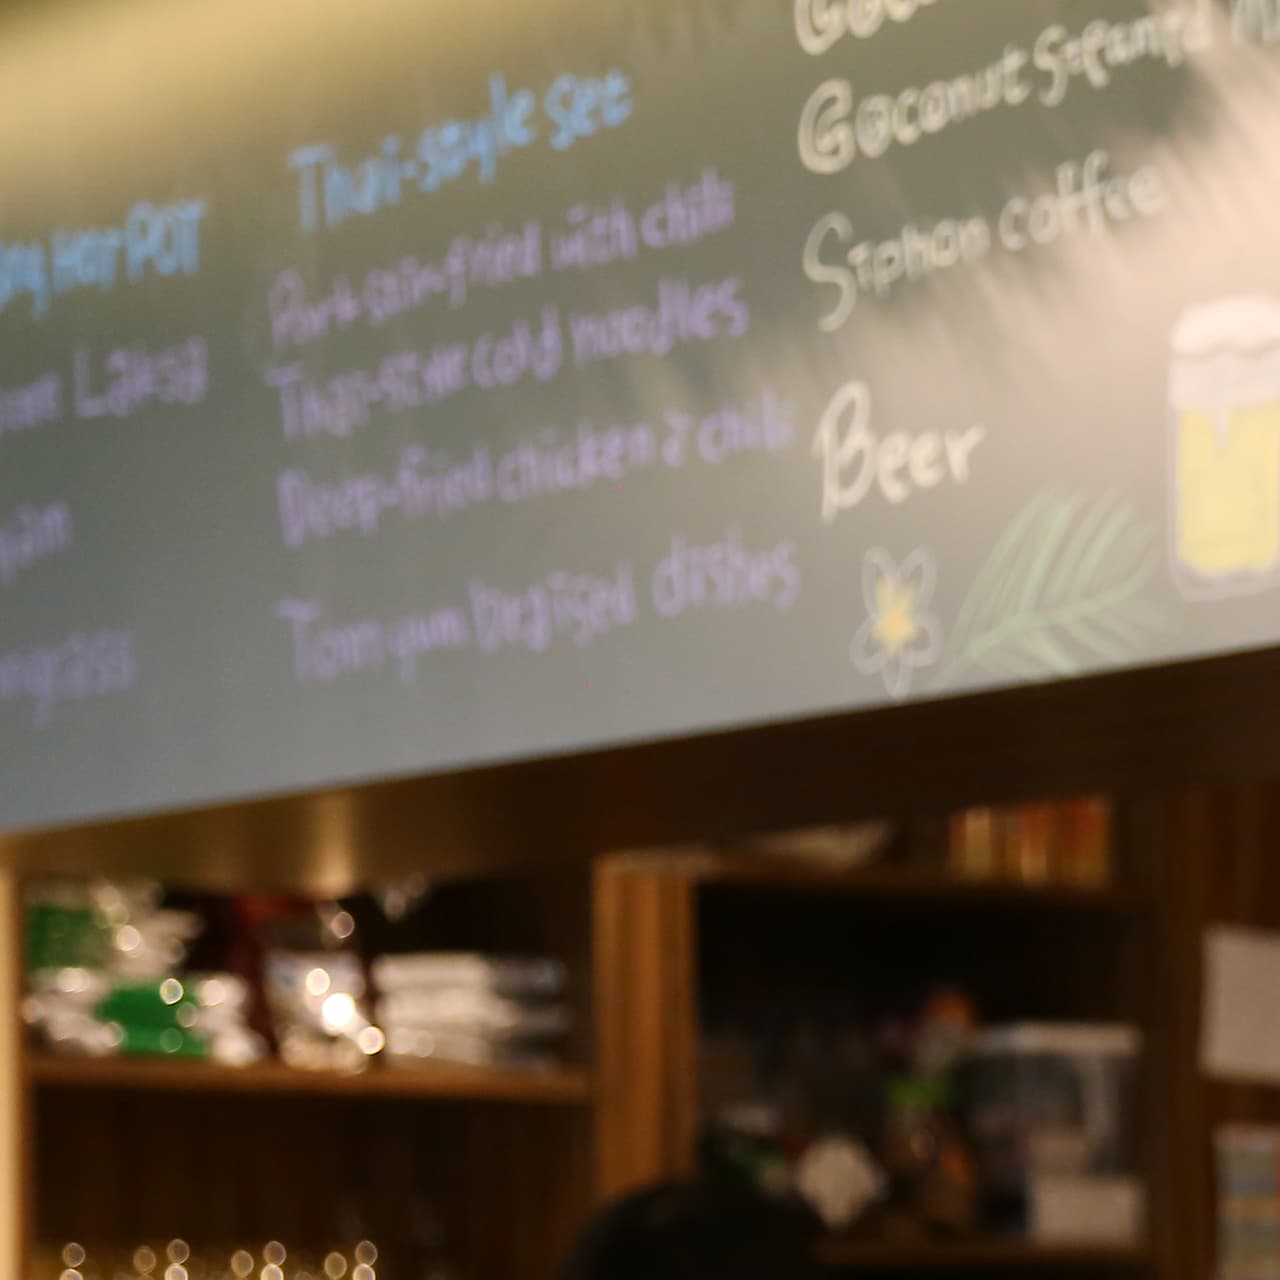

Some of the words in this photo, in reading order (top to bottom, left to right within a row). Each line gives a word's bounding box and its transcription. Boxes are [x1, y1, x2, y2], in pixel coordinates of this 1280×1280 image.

[288, 72, 536, 234] Thai-style
[470, 304, 564, 391] cold
[568, 272, 752, 369] noodles
[811, 380, 988, 526] Beer
[652, 526, 799, 617] dishes
